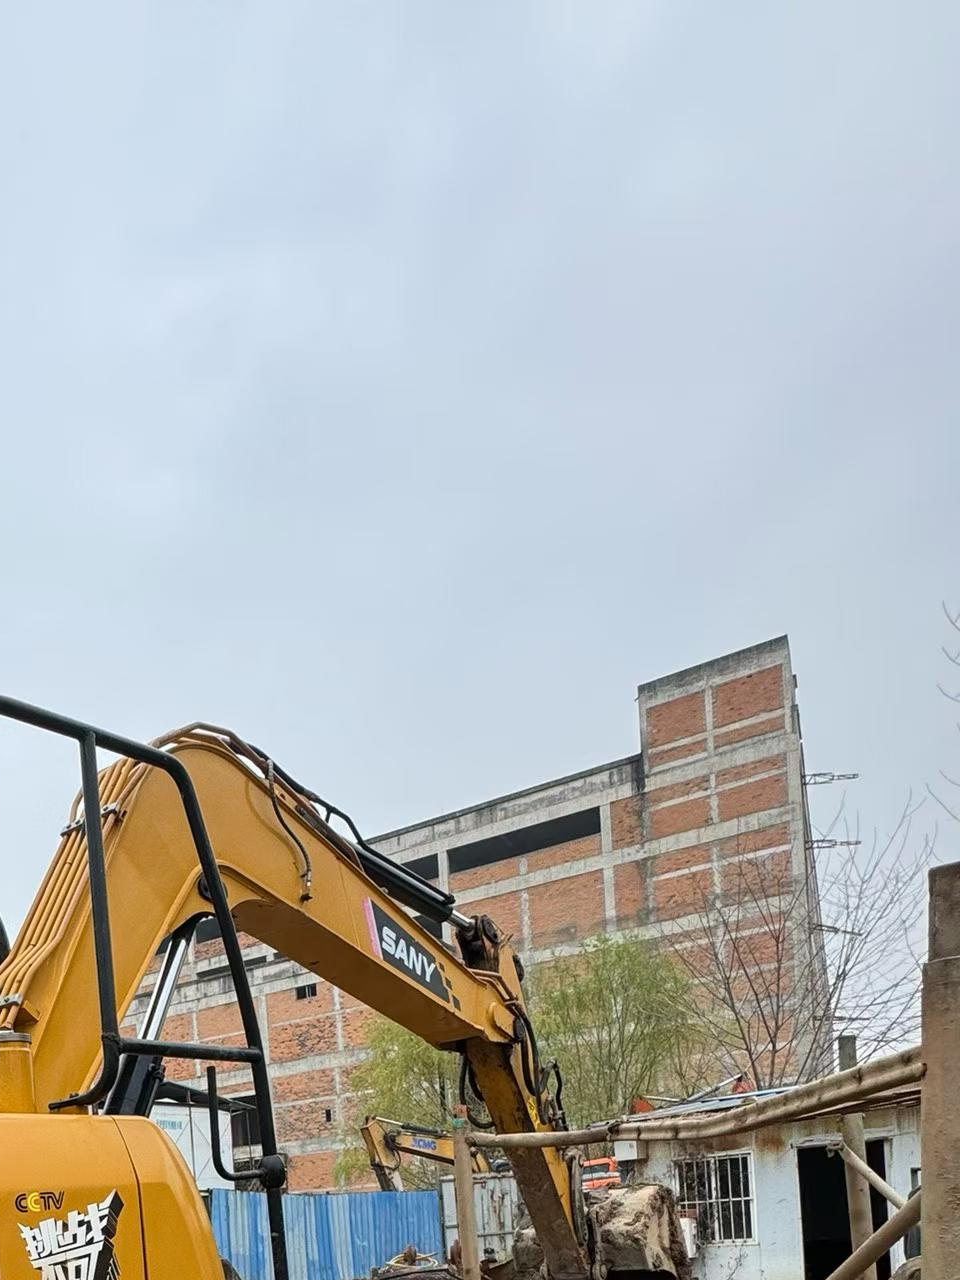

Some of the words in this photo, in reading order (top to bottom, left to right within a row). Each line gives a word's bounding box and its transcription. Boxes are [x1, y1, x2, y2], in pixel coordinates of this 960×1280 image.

[381, 926, 436, 983] SANY
[15, 1191, 65, 1213] CCTV
[17, 1188, 116, 1260] 挑战
